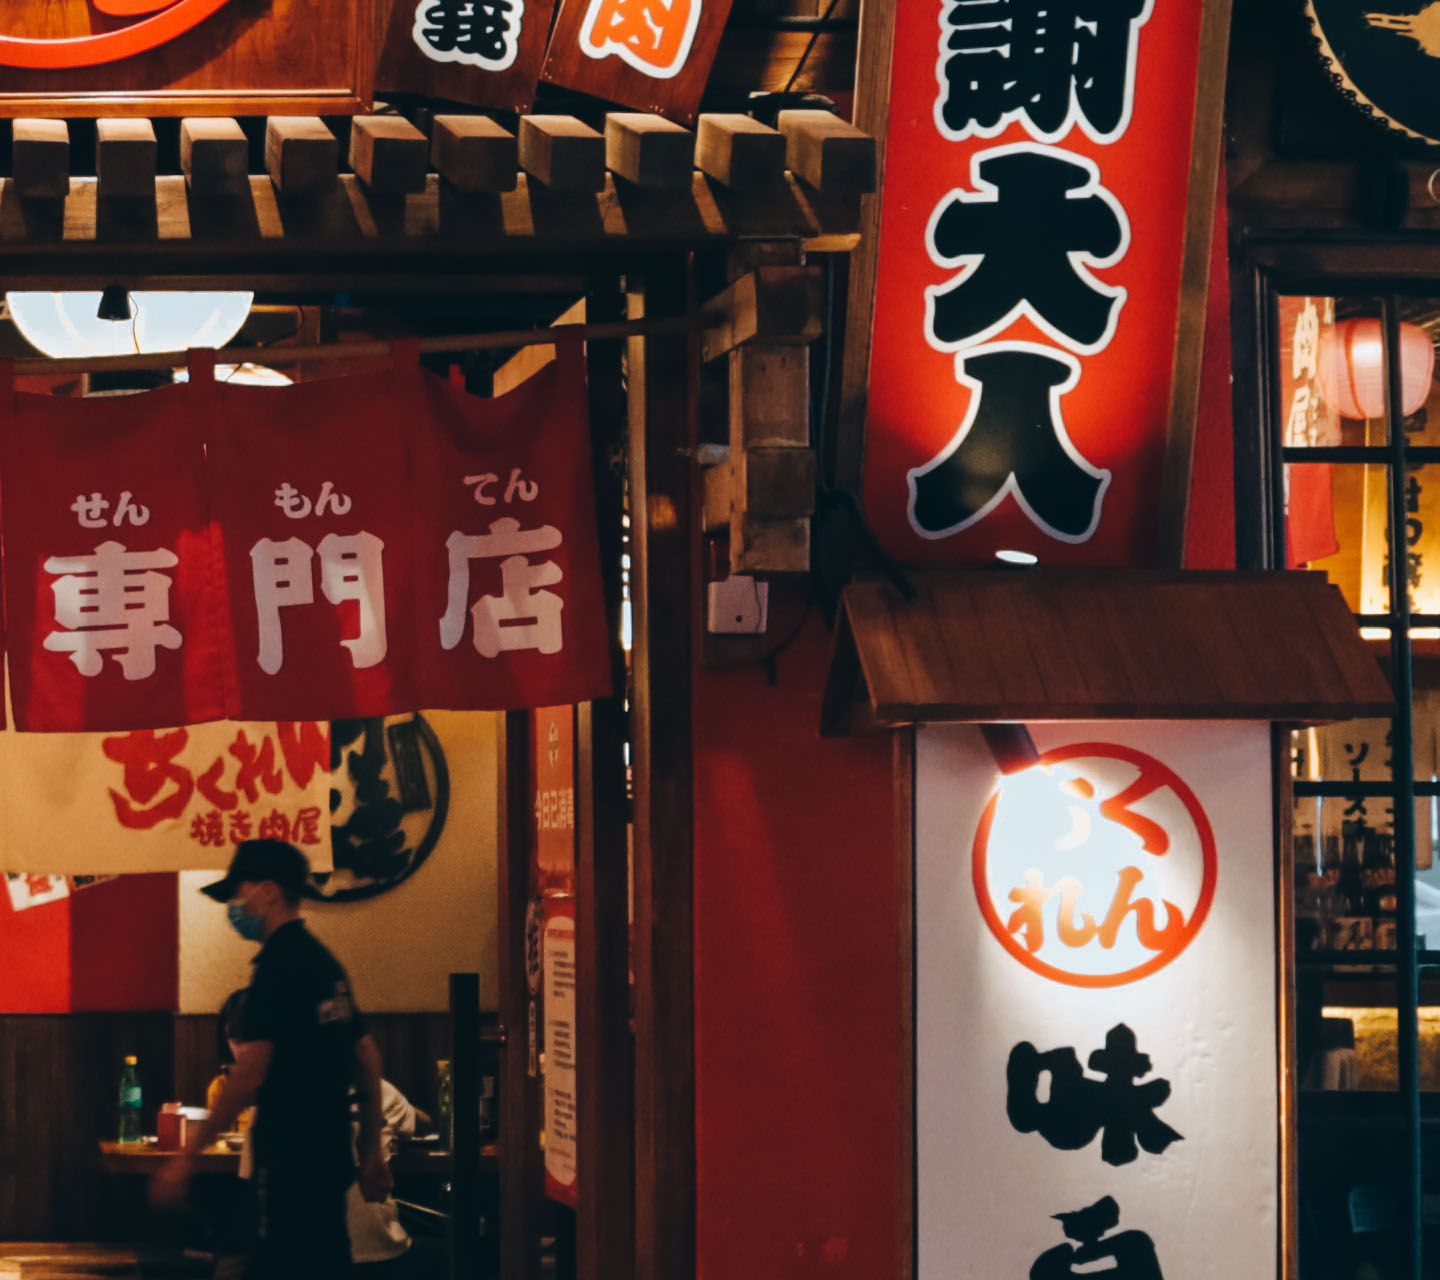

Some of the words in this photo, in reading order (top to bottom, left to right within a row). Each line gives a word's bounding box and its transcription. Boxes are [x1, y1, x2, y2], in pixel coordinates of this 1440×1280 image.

[71, 488, 151, 529] せん
[273, 481, 353, 519] もん
[463, 467, 540, 505] てん
